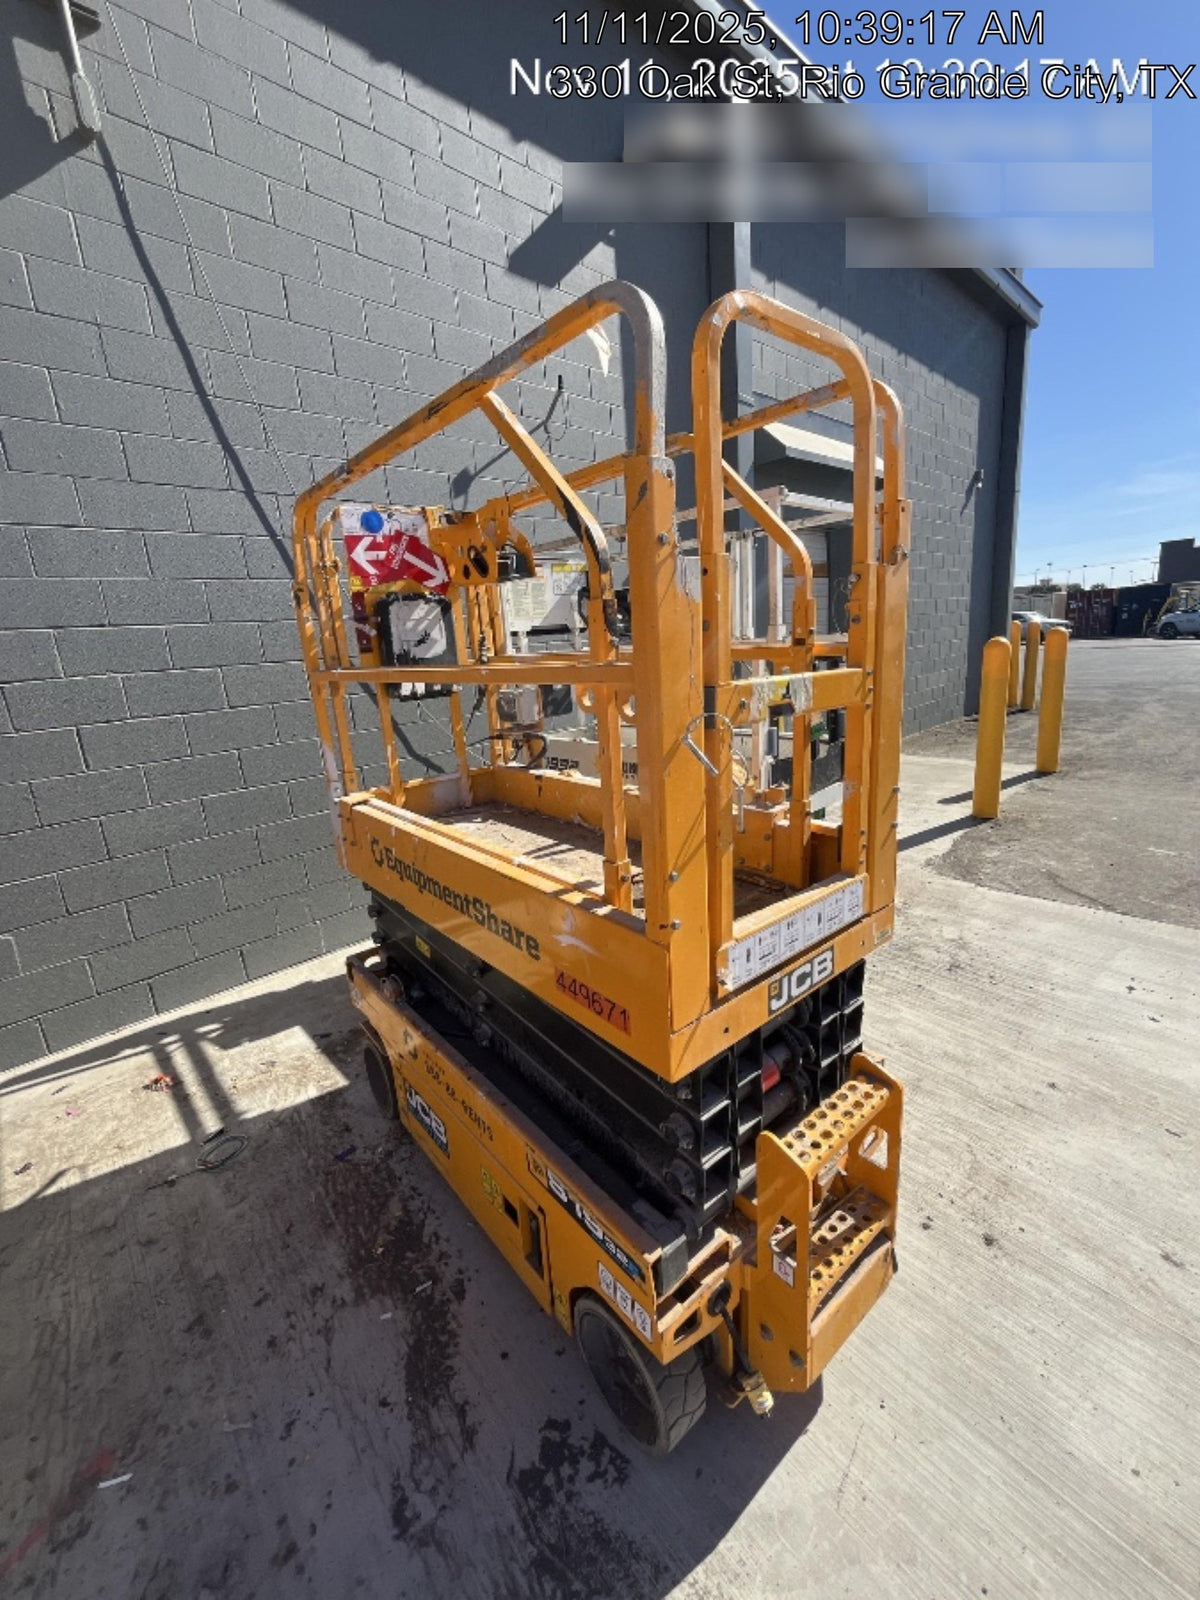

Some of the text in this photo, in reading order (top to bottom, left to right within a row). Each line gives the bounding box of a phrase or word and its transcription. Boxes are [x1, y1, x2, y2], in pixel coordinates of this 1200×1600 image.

[383, 847, 542, 961] EquipmentShare
[555, 971, 630, 1031] 449671
[769, 950, 833, 1012] JCB
[406, 1084, 448, 1144] JCB
